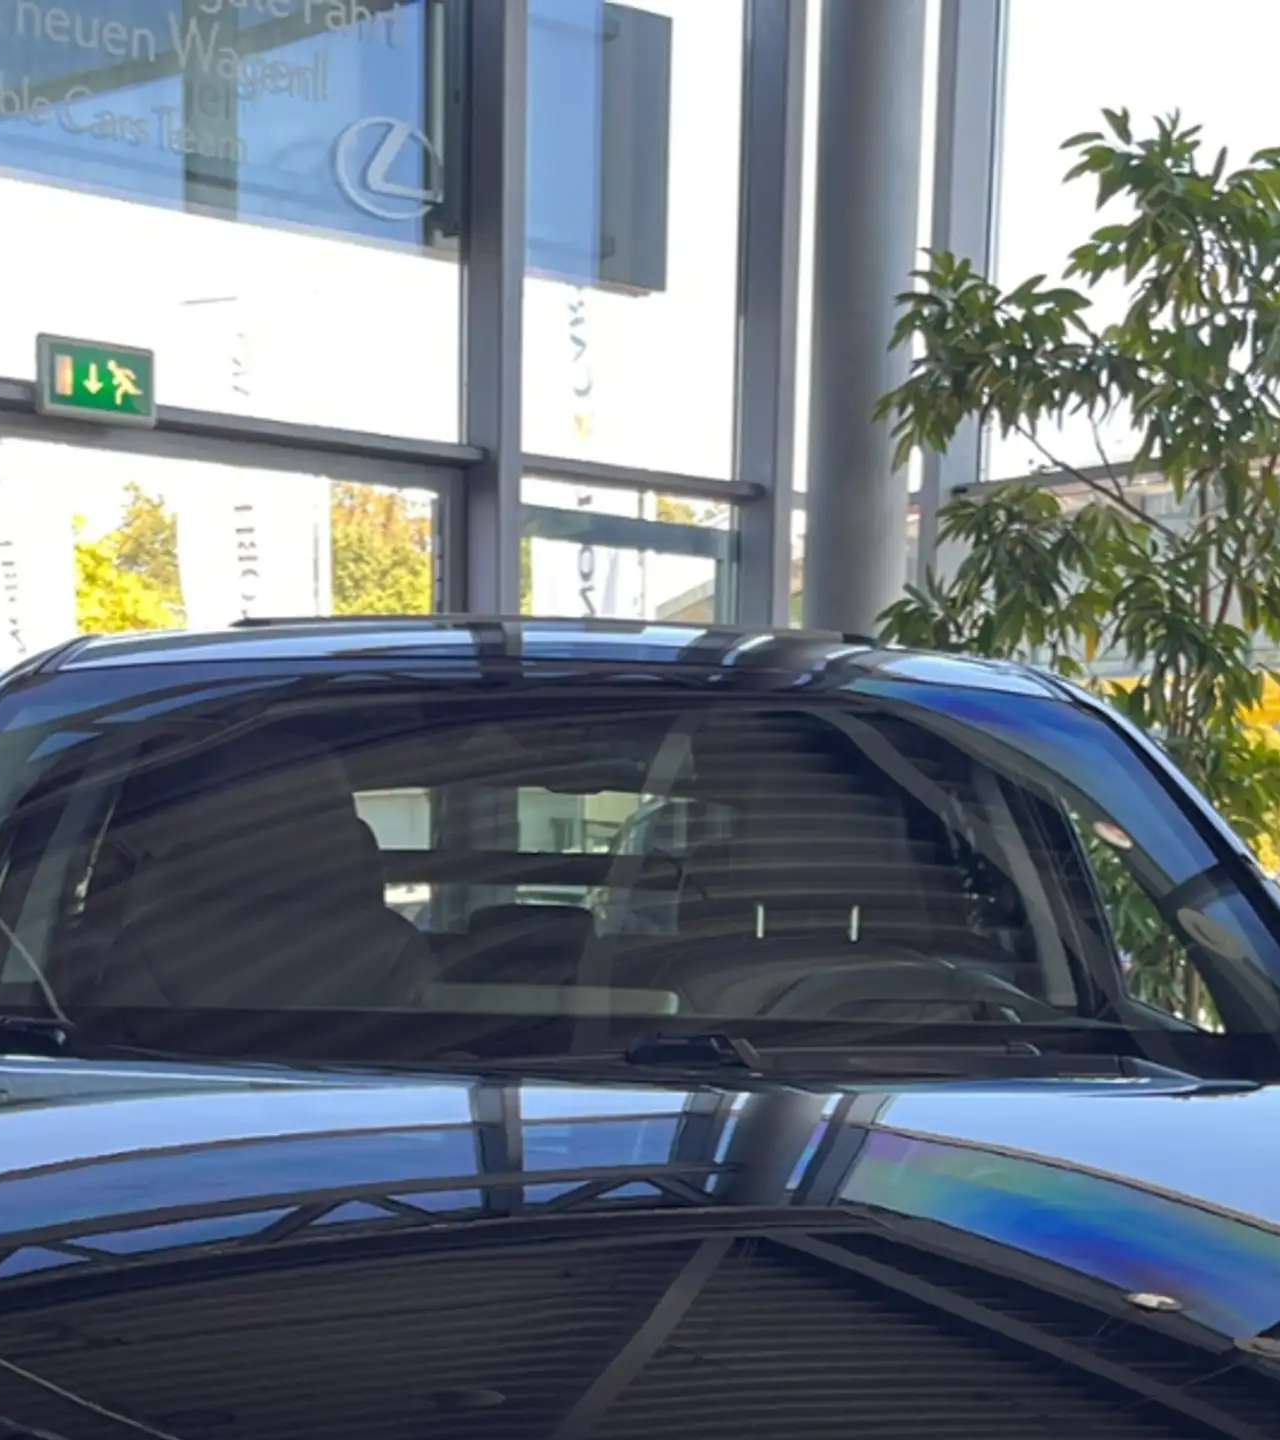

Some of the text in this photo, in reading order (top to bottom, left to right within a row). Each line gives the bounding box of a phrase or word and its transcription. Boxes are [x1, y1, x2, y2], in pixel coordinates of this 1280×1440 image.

[17, 1, 156, 62] neuen
[56, 84, 149, 147] Cars
[150, 104, 247, 163] Team
